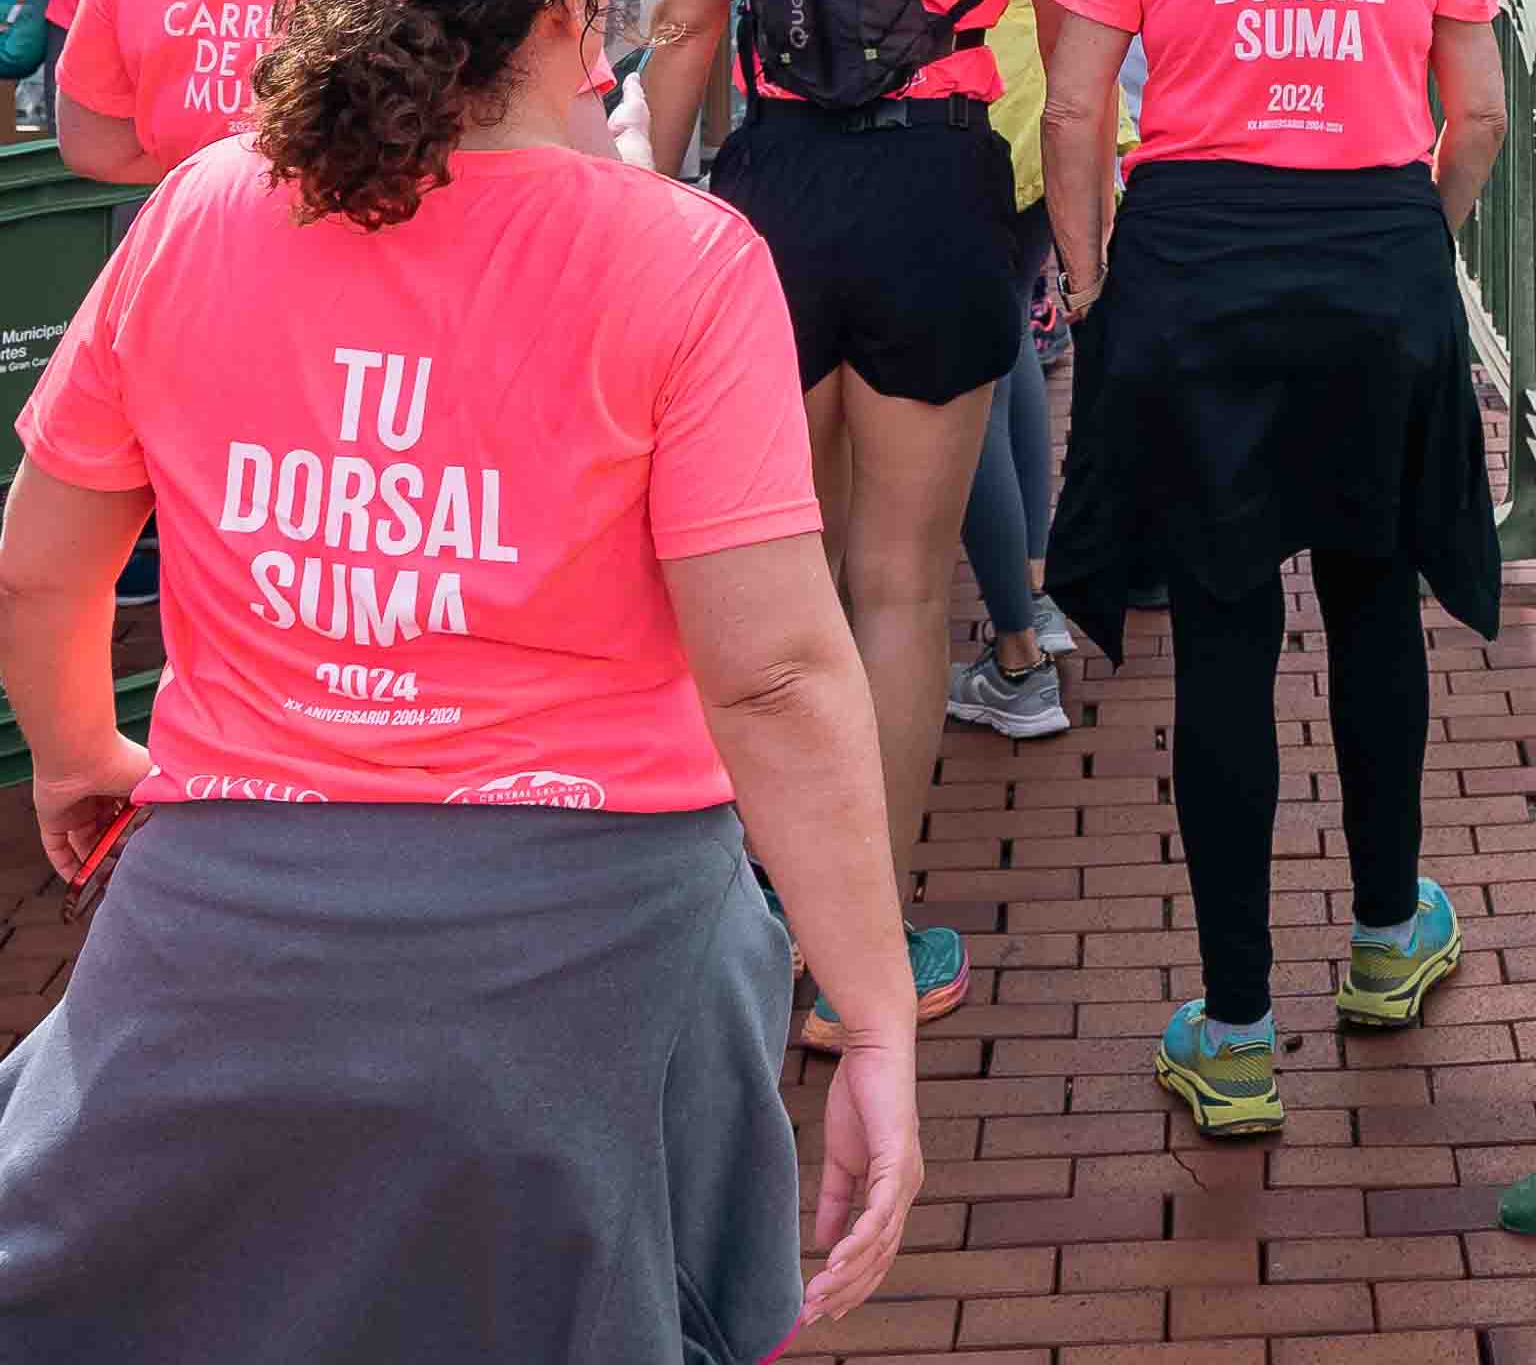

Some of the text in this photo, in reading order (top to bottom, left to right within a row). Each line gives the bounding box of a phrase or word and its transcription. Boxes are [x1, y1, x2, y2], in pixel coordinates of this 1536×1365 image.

[1234, 8, 1364, 62] SUMA
[194, 38, 242, 77] DE
[1267, 84, 1325, 113] 2024
[2, 321, 68, 346] Municipal
[333, 347, 433, 453] TU
[219, 441, 520, 563] DORSAL
[249, 550, 471, 648] SUMA
[316, 663, 419, 702] 2024
[303, 705, 391, 725] ANIVERSARIO
[391, 707, 462, 726] 2004-2024
